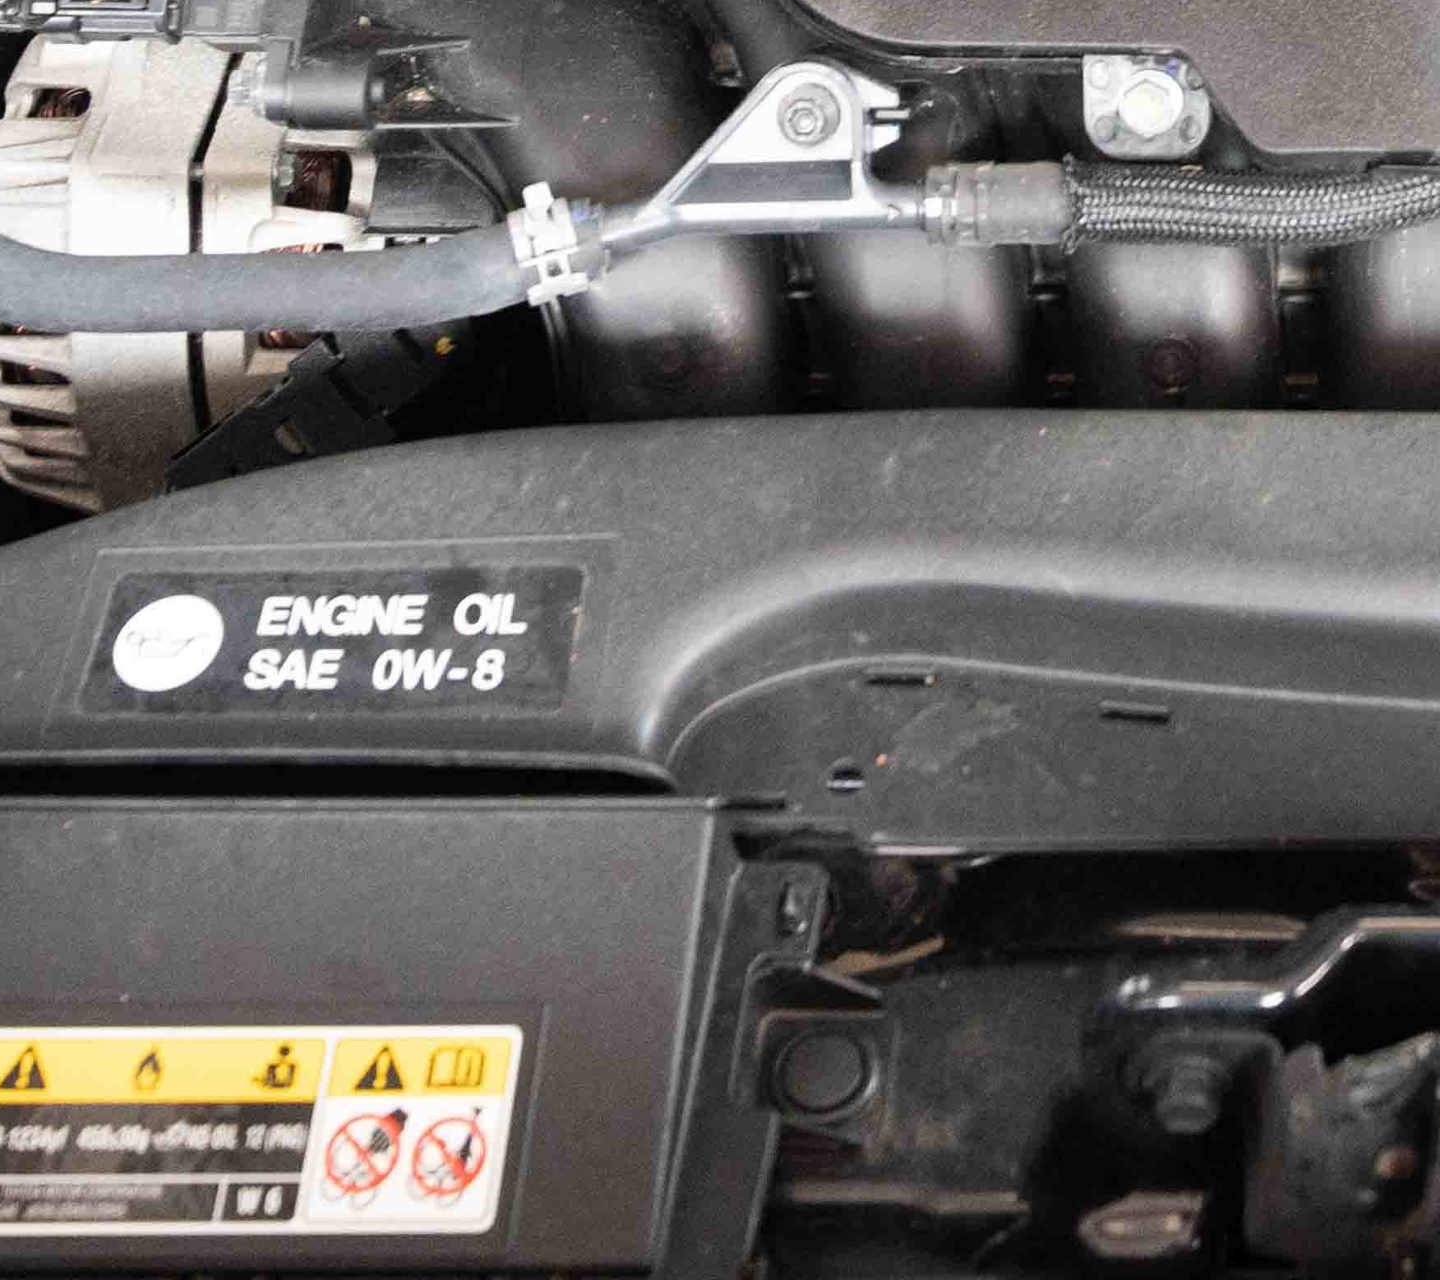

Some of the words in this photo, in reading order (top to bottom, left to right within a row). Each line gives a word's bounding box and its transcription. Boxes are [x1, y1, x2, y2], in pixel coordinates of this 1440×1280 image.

[256, 593, 429, 637] ENGINE
[453, 592, 529, 636] OIL
[243, 648, 345, 691] SAE
[371, 647, 507, 692] 0W-8
